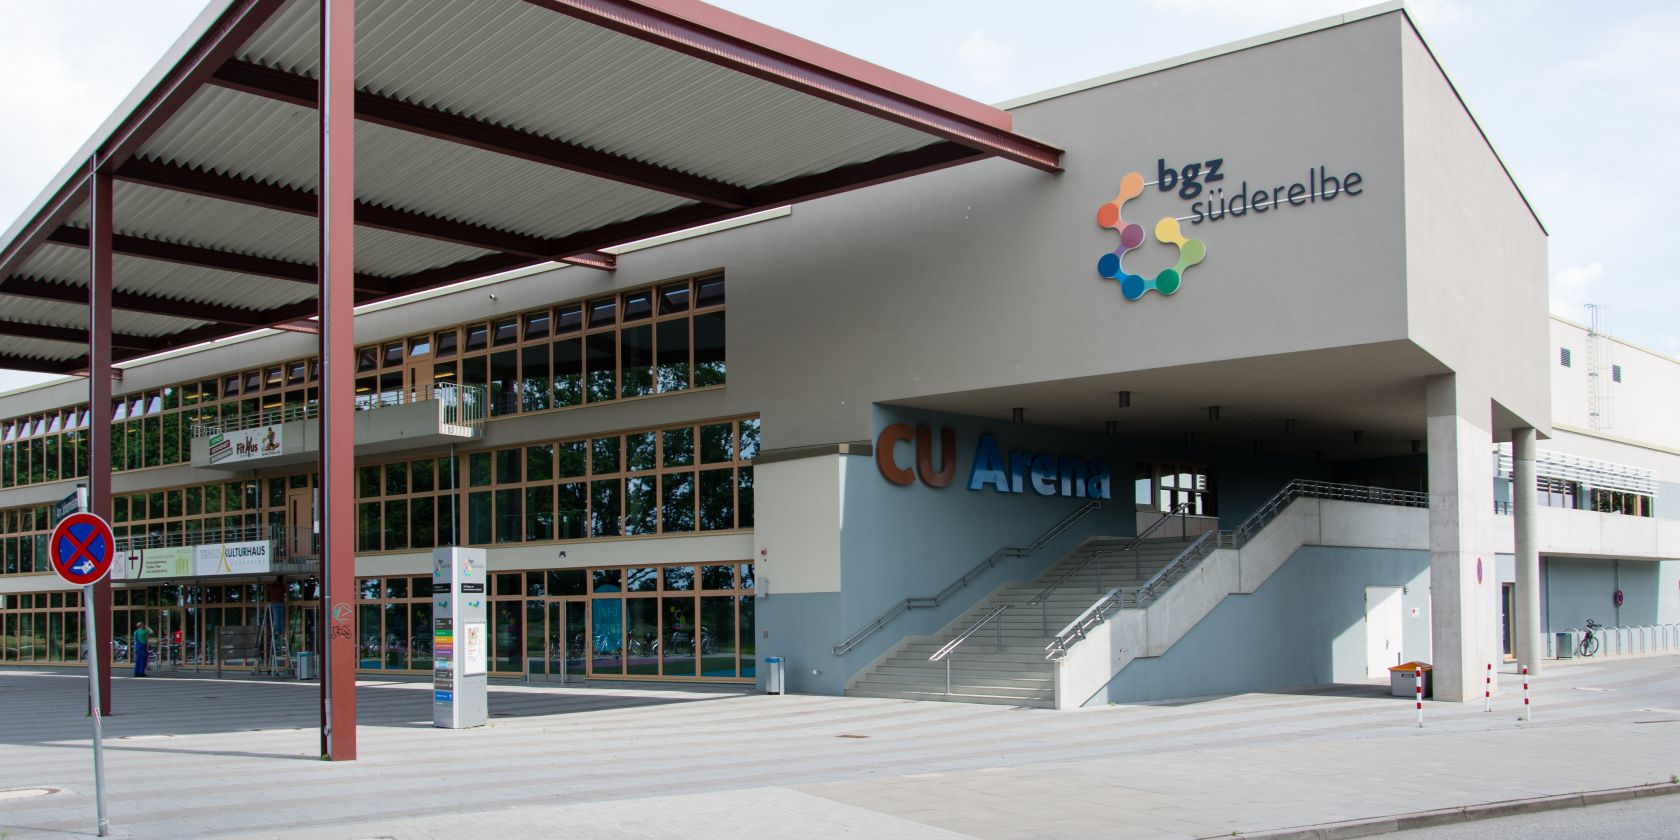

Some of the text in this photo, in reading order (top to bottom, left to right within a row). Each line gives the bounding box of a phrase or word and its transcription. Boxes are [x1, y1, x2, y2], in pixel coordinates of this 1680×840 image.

[1158, 158, 1224, 199] bgz
[1191, 166, 1363, 225] süderelbe
[876, 422, 1111, 499] CU Arena
[224, 546, 266, 557] KULTURHAUS
[598, 607, 618, 617] INFO
